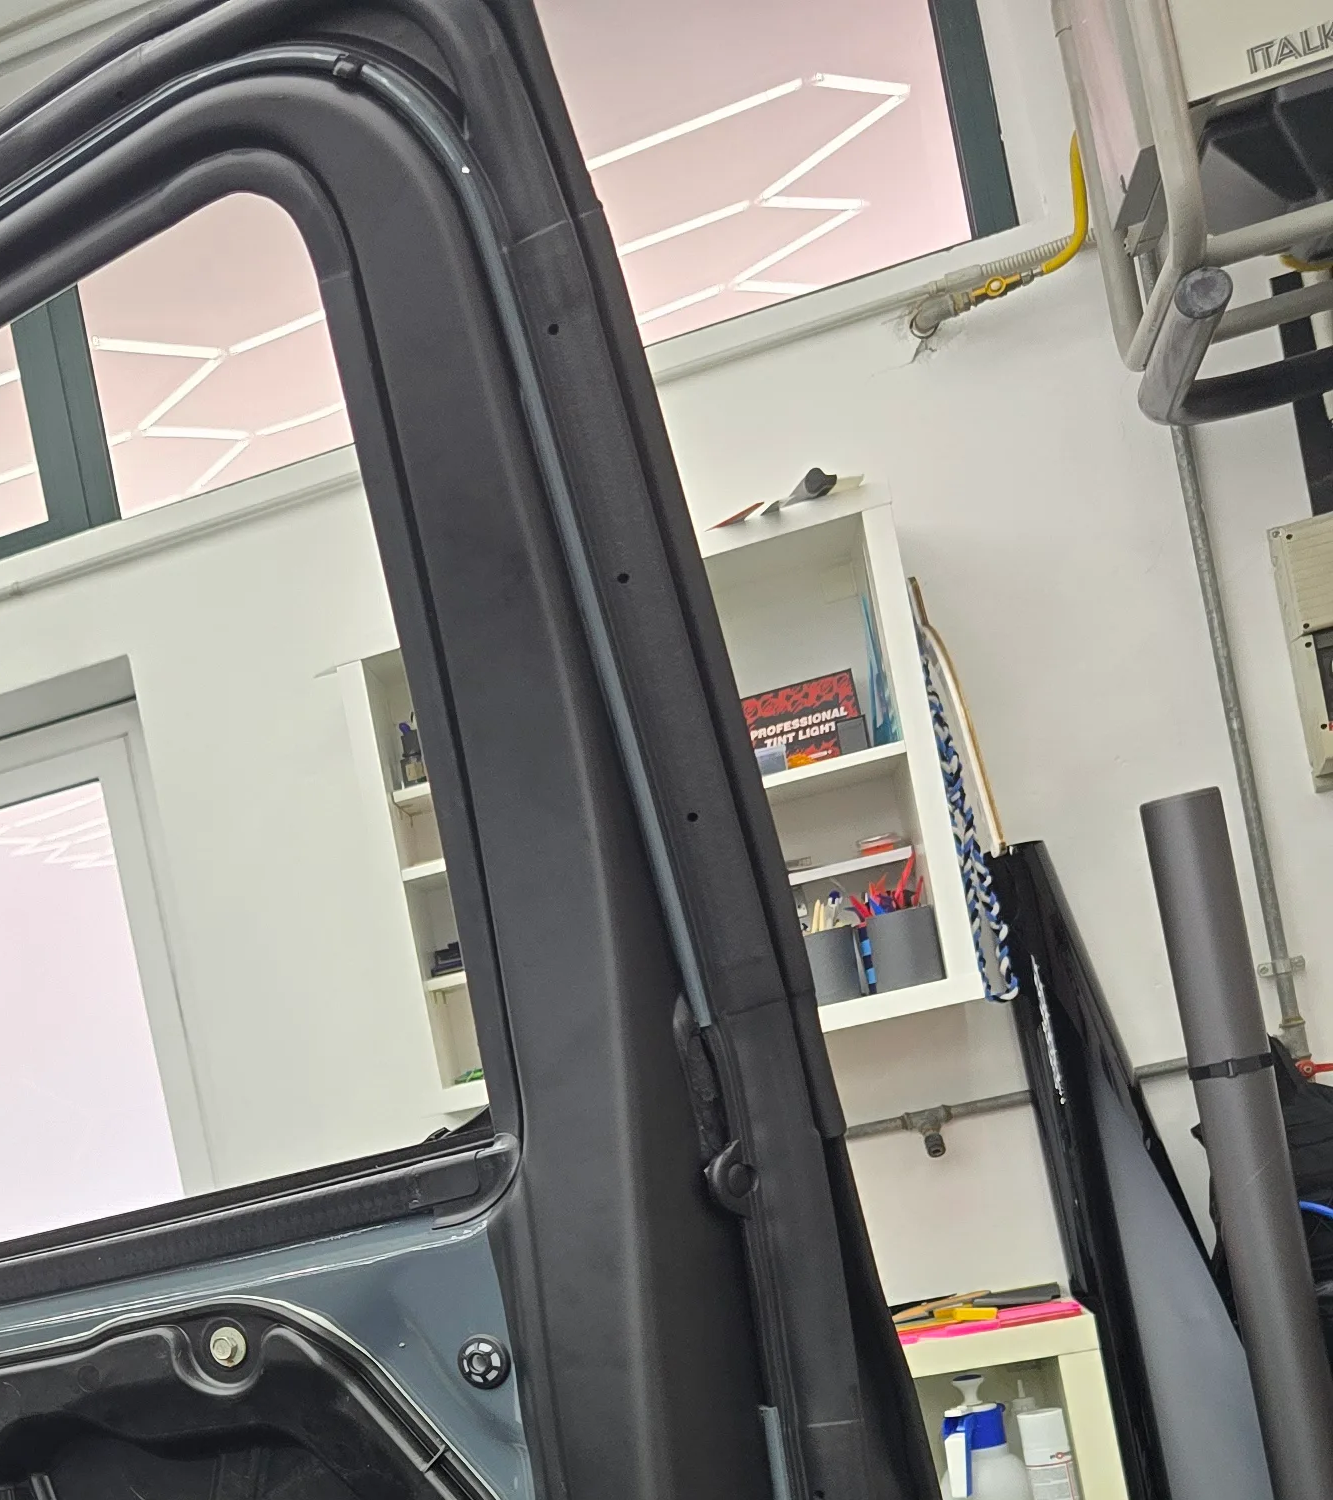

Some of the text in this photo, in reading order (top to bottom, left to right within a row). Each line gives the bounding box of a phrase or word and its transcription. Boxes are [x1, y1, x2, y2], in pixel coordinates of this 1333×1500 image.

[750, 706, 848, 742] PROFESSIONAL
[764, 720, 836, 748] TINT LIGHT
